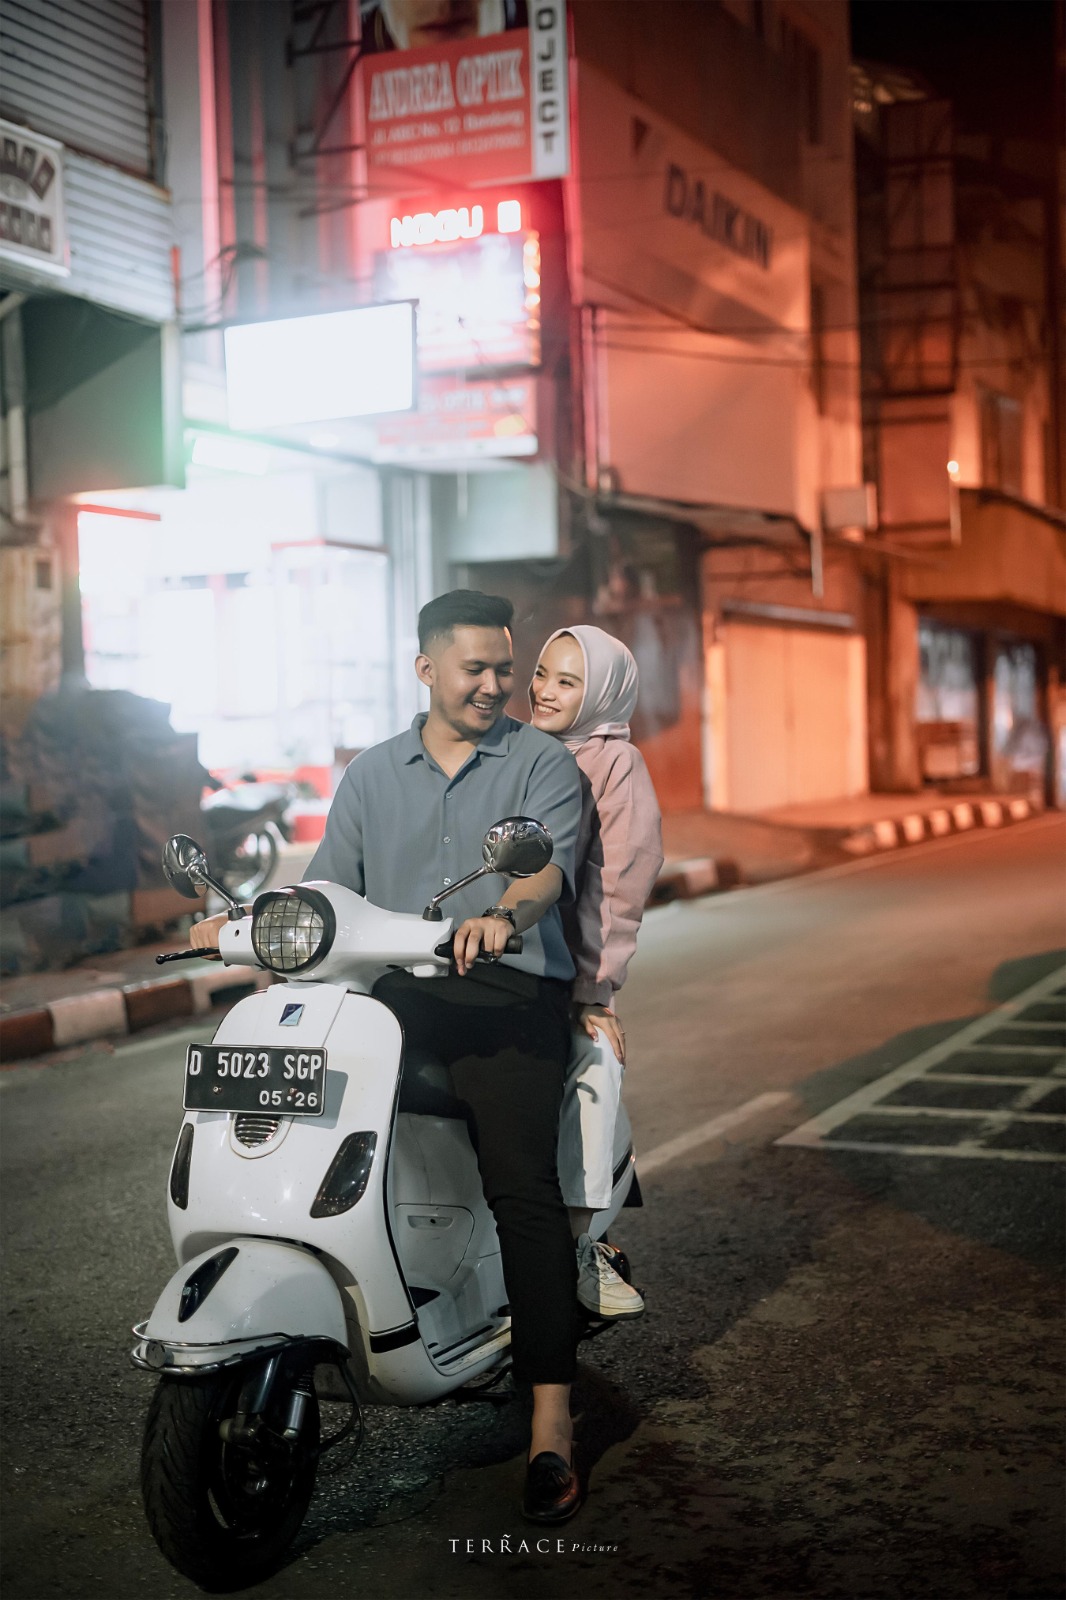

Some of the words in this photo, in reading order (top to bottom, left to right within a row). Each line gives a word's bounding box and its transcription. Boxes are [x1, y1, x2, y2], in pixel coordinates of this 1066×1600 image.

[369, 62, 455, 121] ANDREA
[457, 50, 525, 106] OPTIK
[664, 162, 773, 271] DAIKIN
[189, 1050, 202, 1076] D
[217, 1052, 270, 1079] 5023
[283, 1054, 322, 1080] SGP
